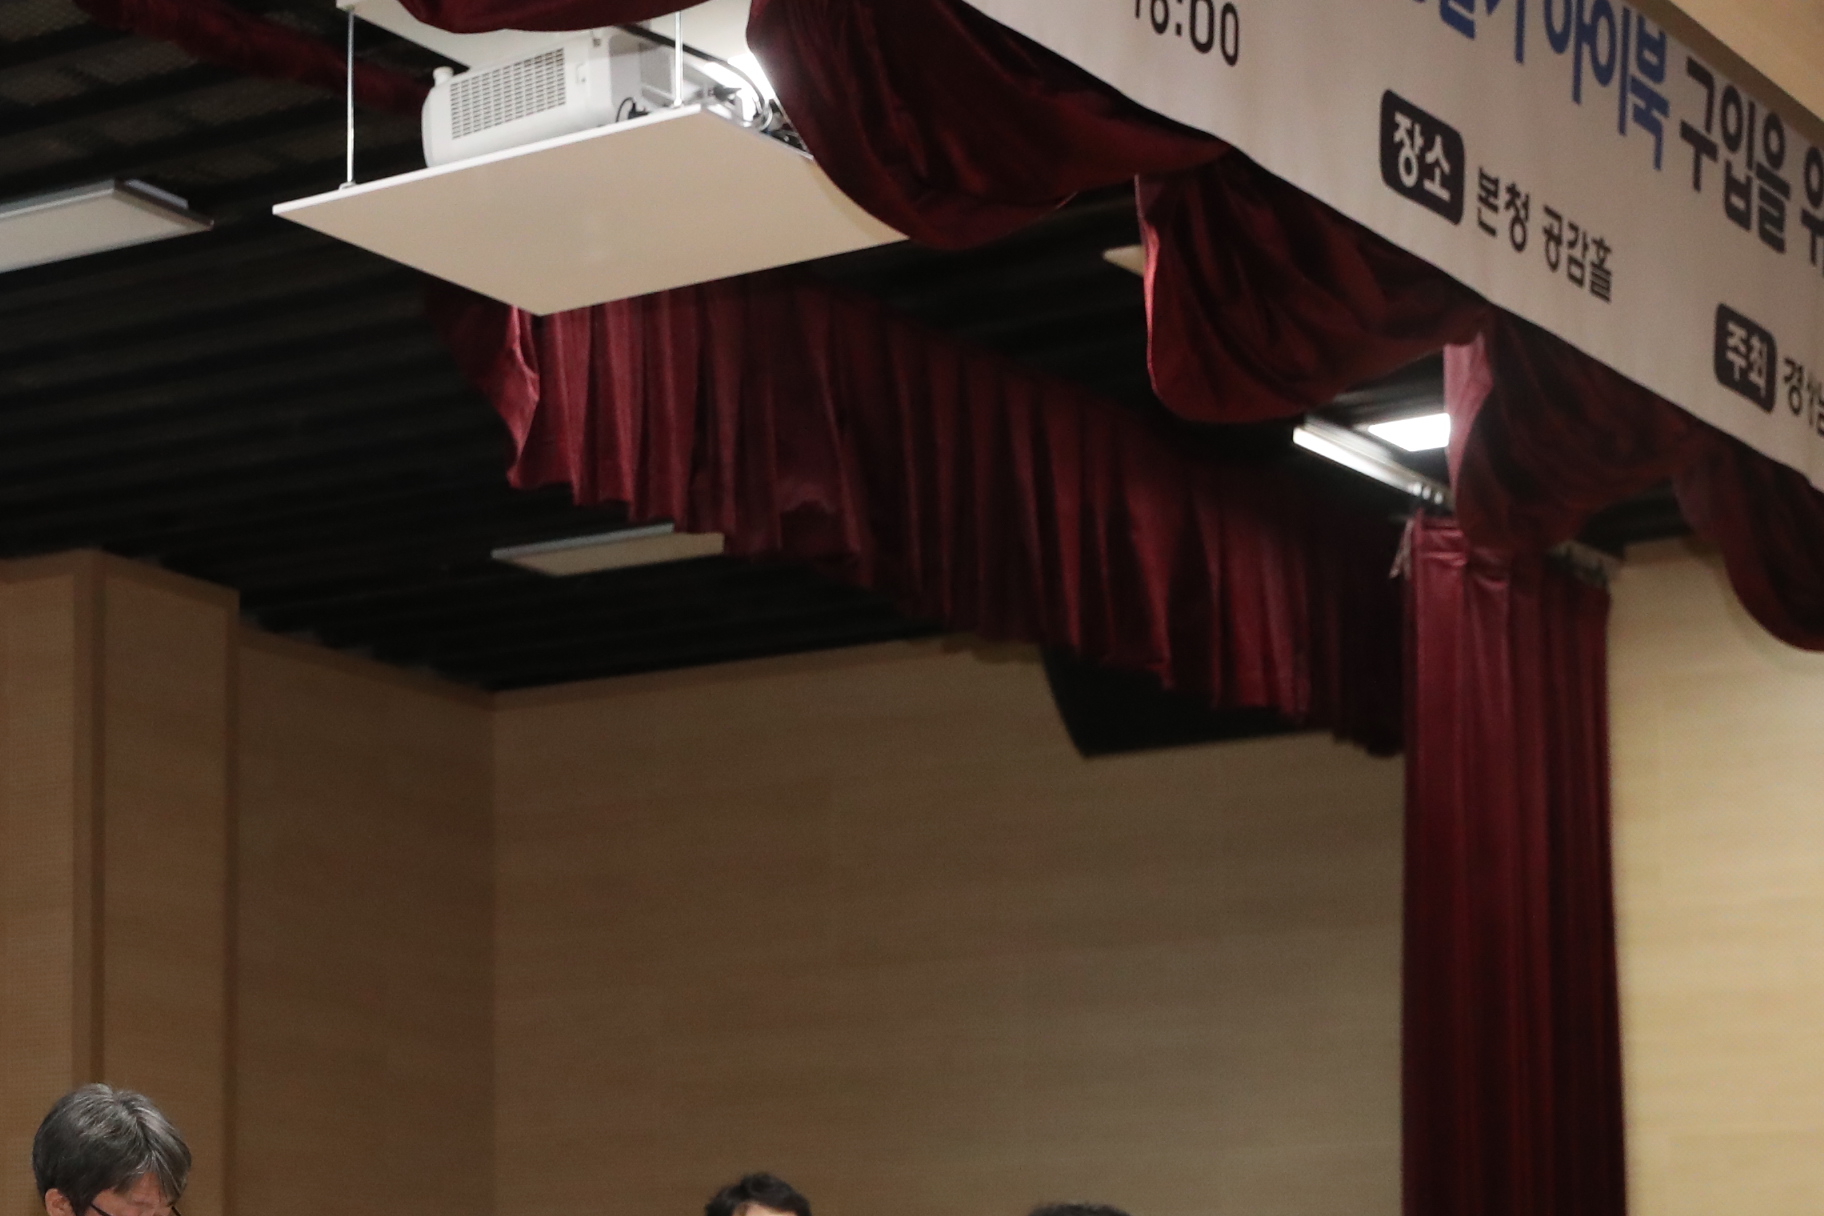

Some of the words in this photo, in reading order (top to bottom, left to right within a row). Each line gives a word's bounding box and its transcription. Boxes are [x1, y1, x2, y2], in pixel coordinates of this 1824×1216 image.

[1393, 111, 1452, 203] 장소
[1679, 54, 1792, 255] 구입을
[1477, 166, 1531, 254] 본청
[1542, 204, 1613, 304] 공감홀
[1726, 321, 1769, 399] 주최
